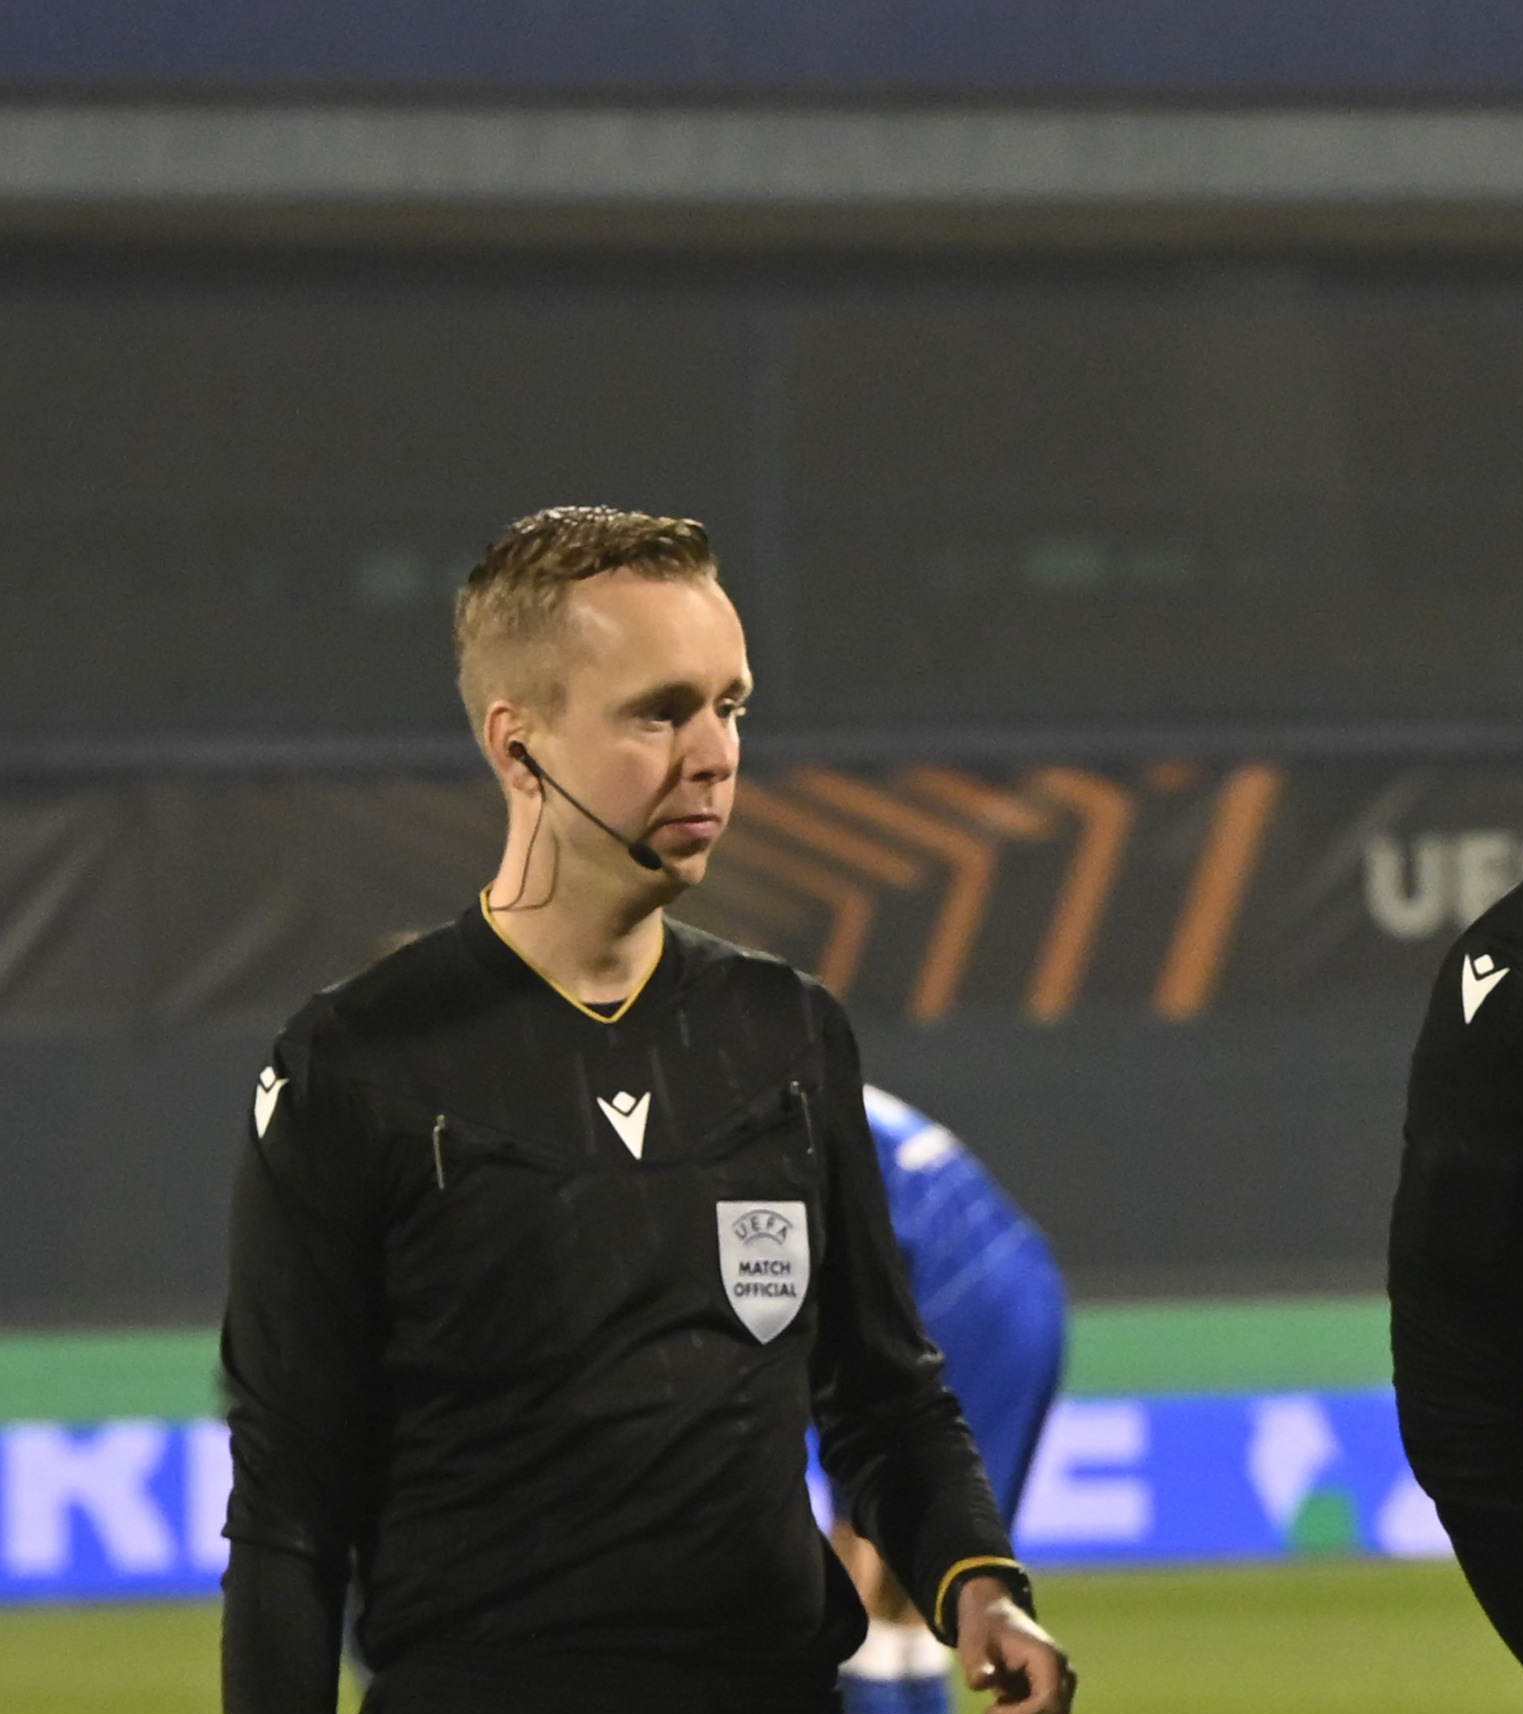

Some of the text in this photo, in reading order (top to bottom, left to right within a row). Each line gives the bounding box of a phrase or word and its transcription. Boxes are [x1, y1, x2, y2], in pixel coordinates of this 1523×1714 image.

[734, 1215, 787, 1240] UEFA
[739, 1260, 791, 1275] MATCH
[733, 1282, 797, 1298] OFFICIAL
